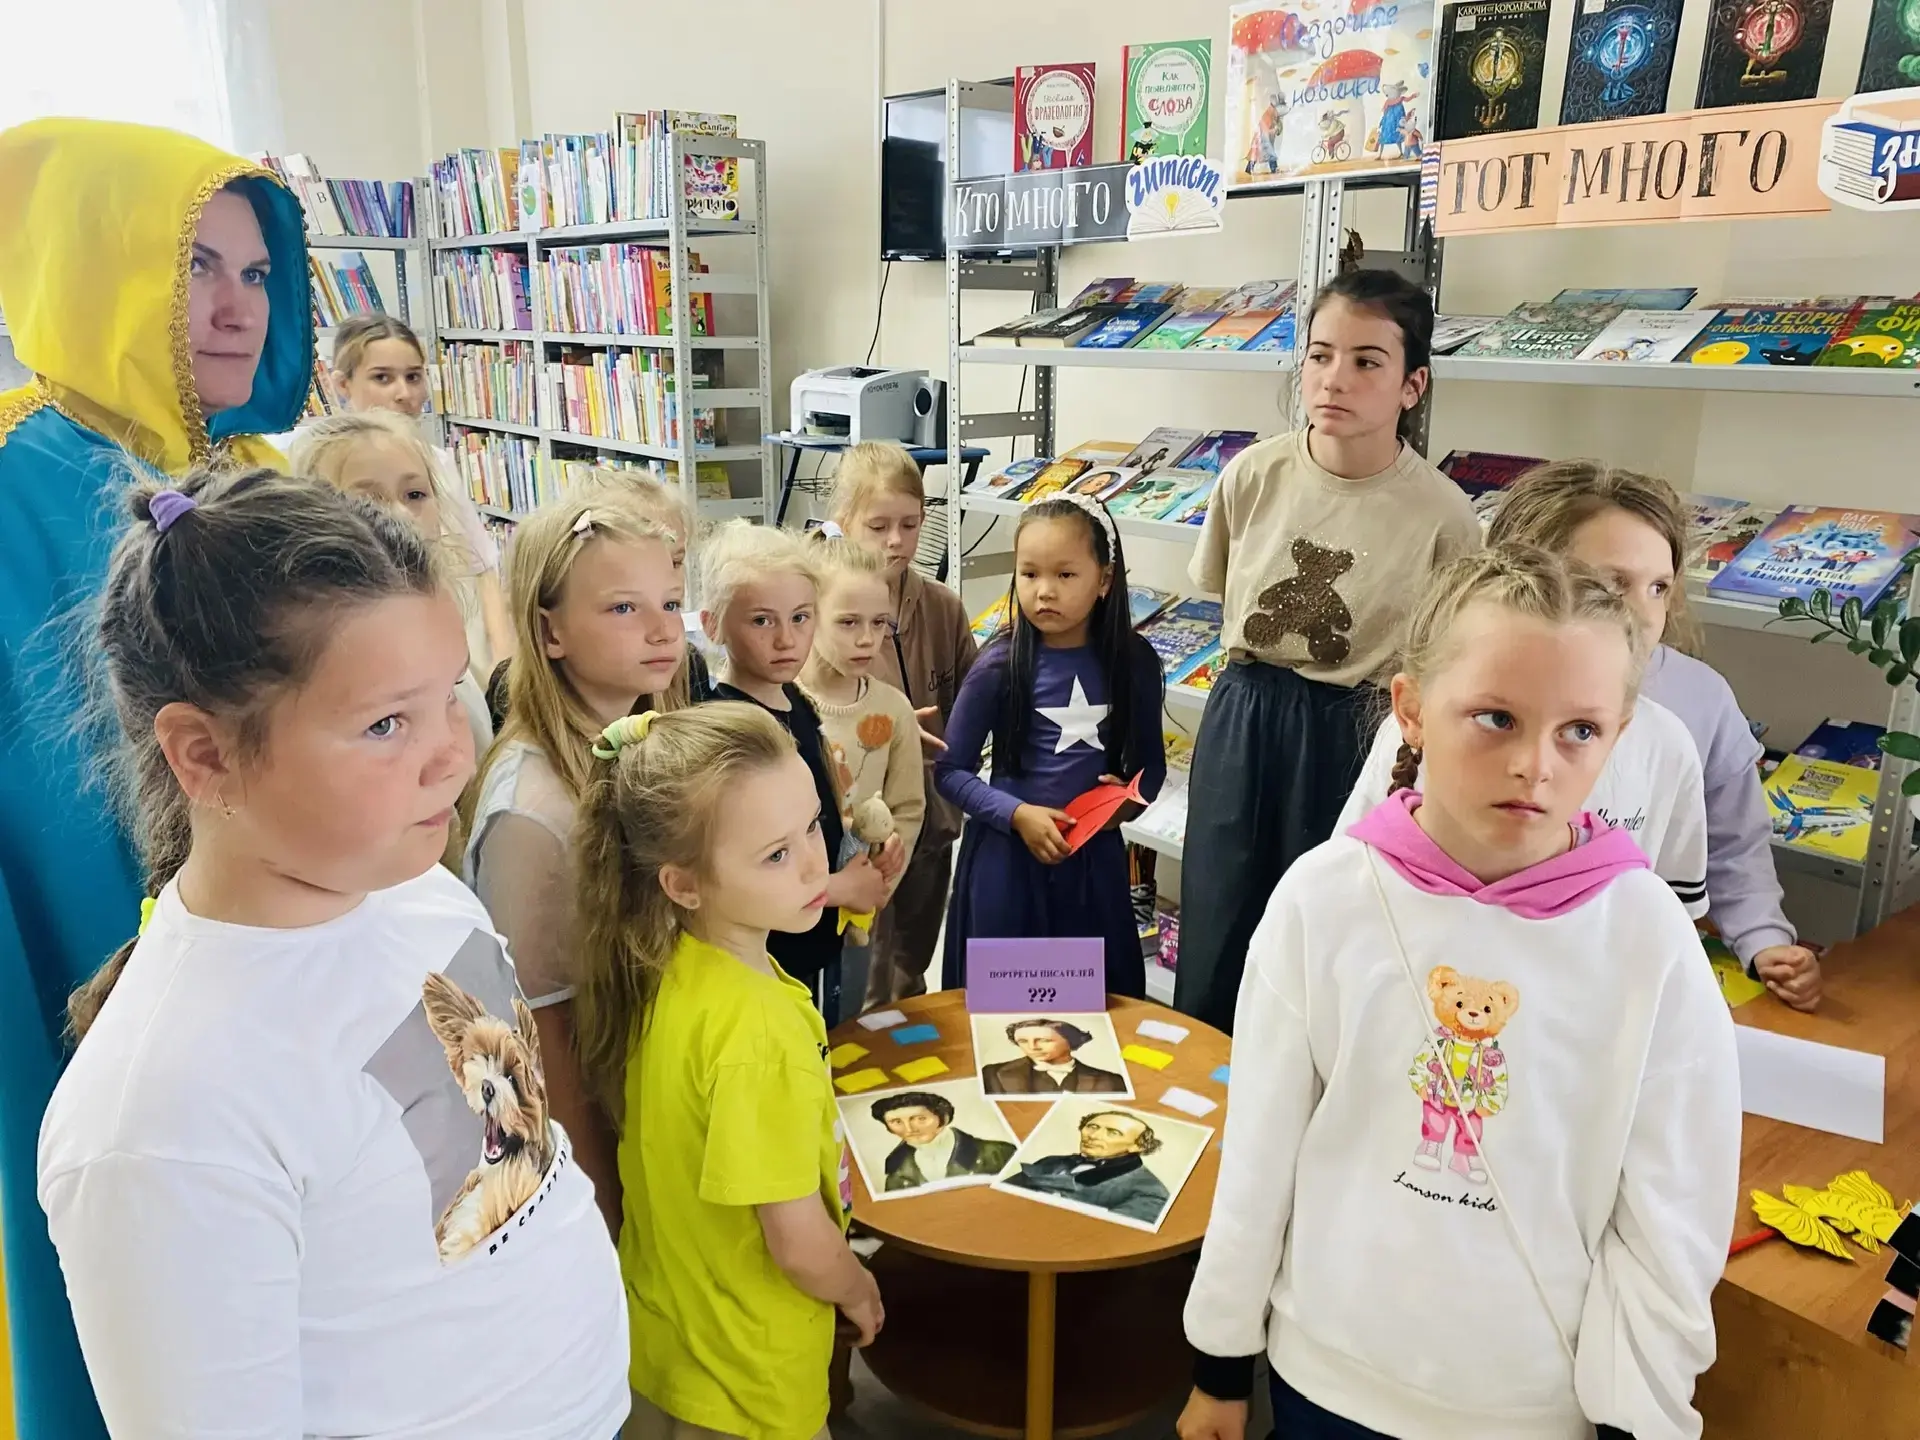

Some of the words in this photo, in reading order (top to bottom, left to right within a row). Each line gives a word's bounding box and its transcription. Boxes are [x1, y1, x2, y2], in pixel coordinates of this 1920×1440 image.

[1034, 104, 1084, 121] ФРАЗЕОЛОГИЯ
[1148, 96, 1193, 116] СЛОВА
[1443, 152, 1551, 216] ТОТ
[1563, 129, 1788, 205] МНОГО
[954, 186, 999, 238] КТО
[1006, 181, 1111, 231] МНОГО
[989, 969, 1038, 979] ПОРТРЕТЫ
[1040, 967, 1095, 979] ПИСАТЕЛЕЙ
[1458, 1192, 1498, 1212] kids
